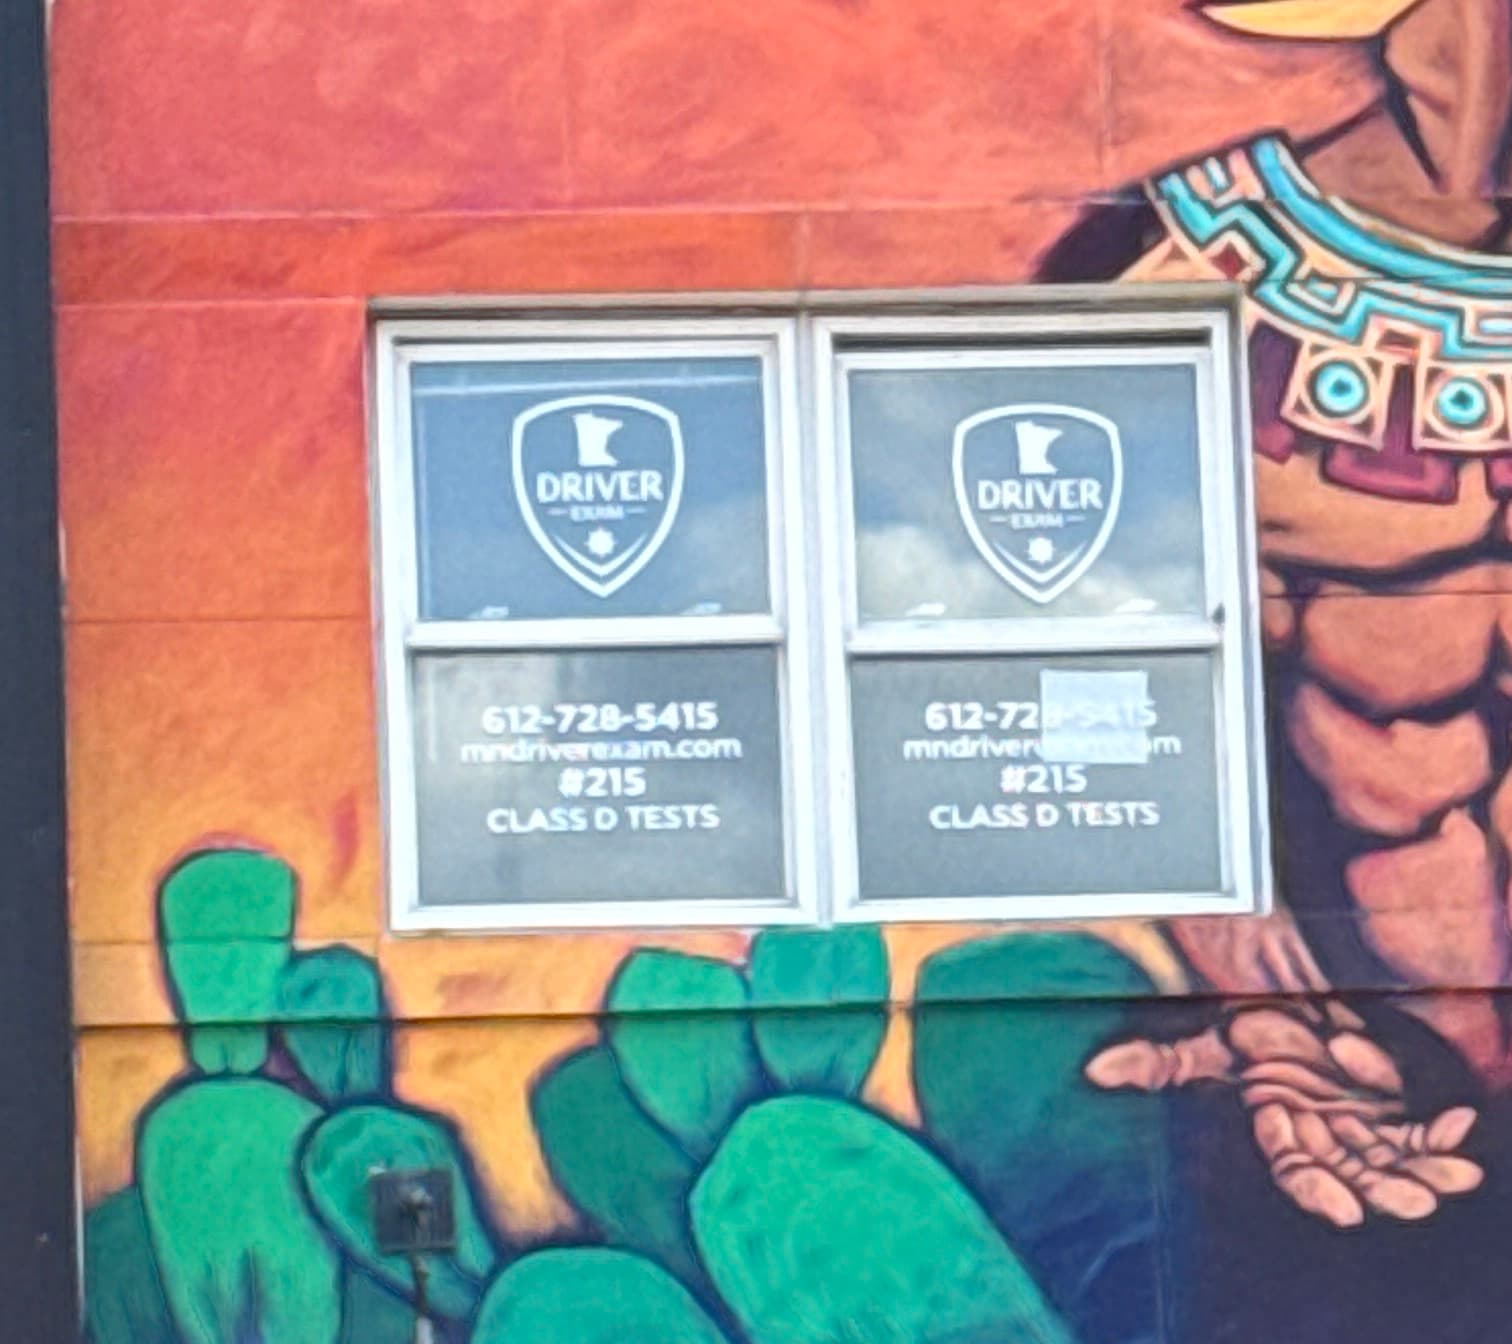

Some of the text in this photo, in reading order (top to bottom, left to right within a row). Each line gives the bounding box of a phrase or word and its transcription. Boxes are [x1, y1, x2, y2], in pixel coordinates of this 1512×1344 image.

[537, 470, 663, 503] DRIVER
[977, 478, 1103, 510] DRIVER
[482, 702, 719, 732] 612-728-5415
[460, 738, 743, 761] mndriverexam.com
[557, 767, 647, 797] #215
[1000, 764, 1088, 793] #215
[486, 803, 721, 834] CLASS D TESTS
[929, 801, 1160, 830] CLASS D TESTS
